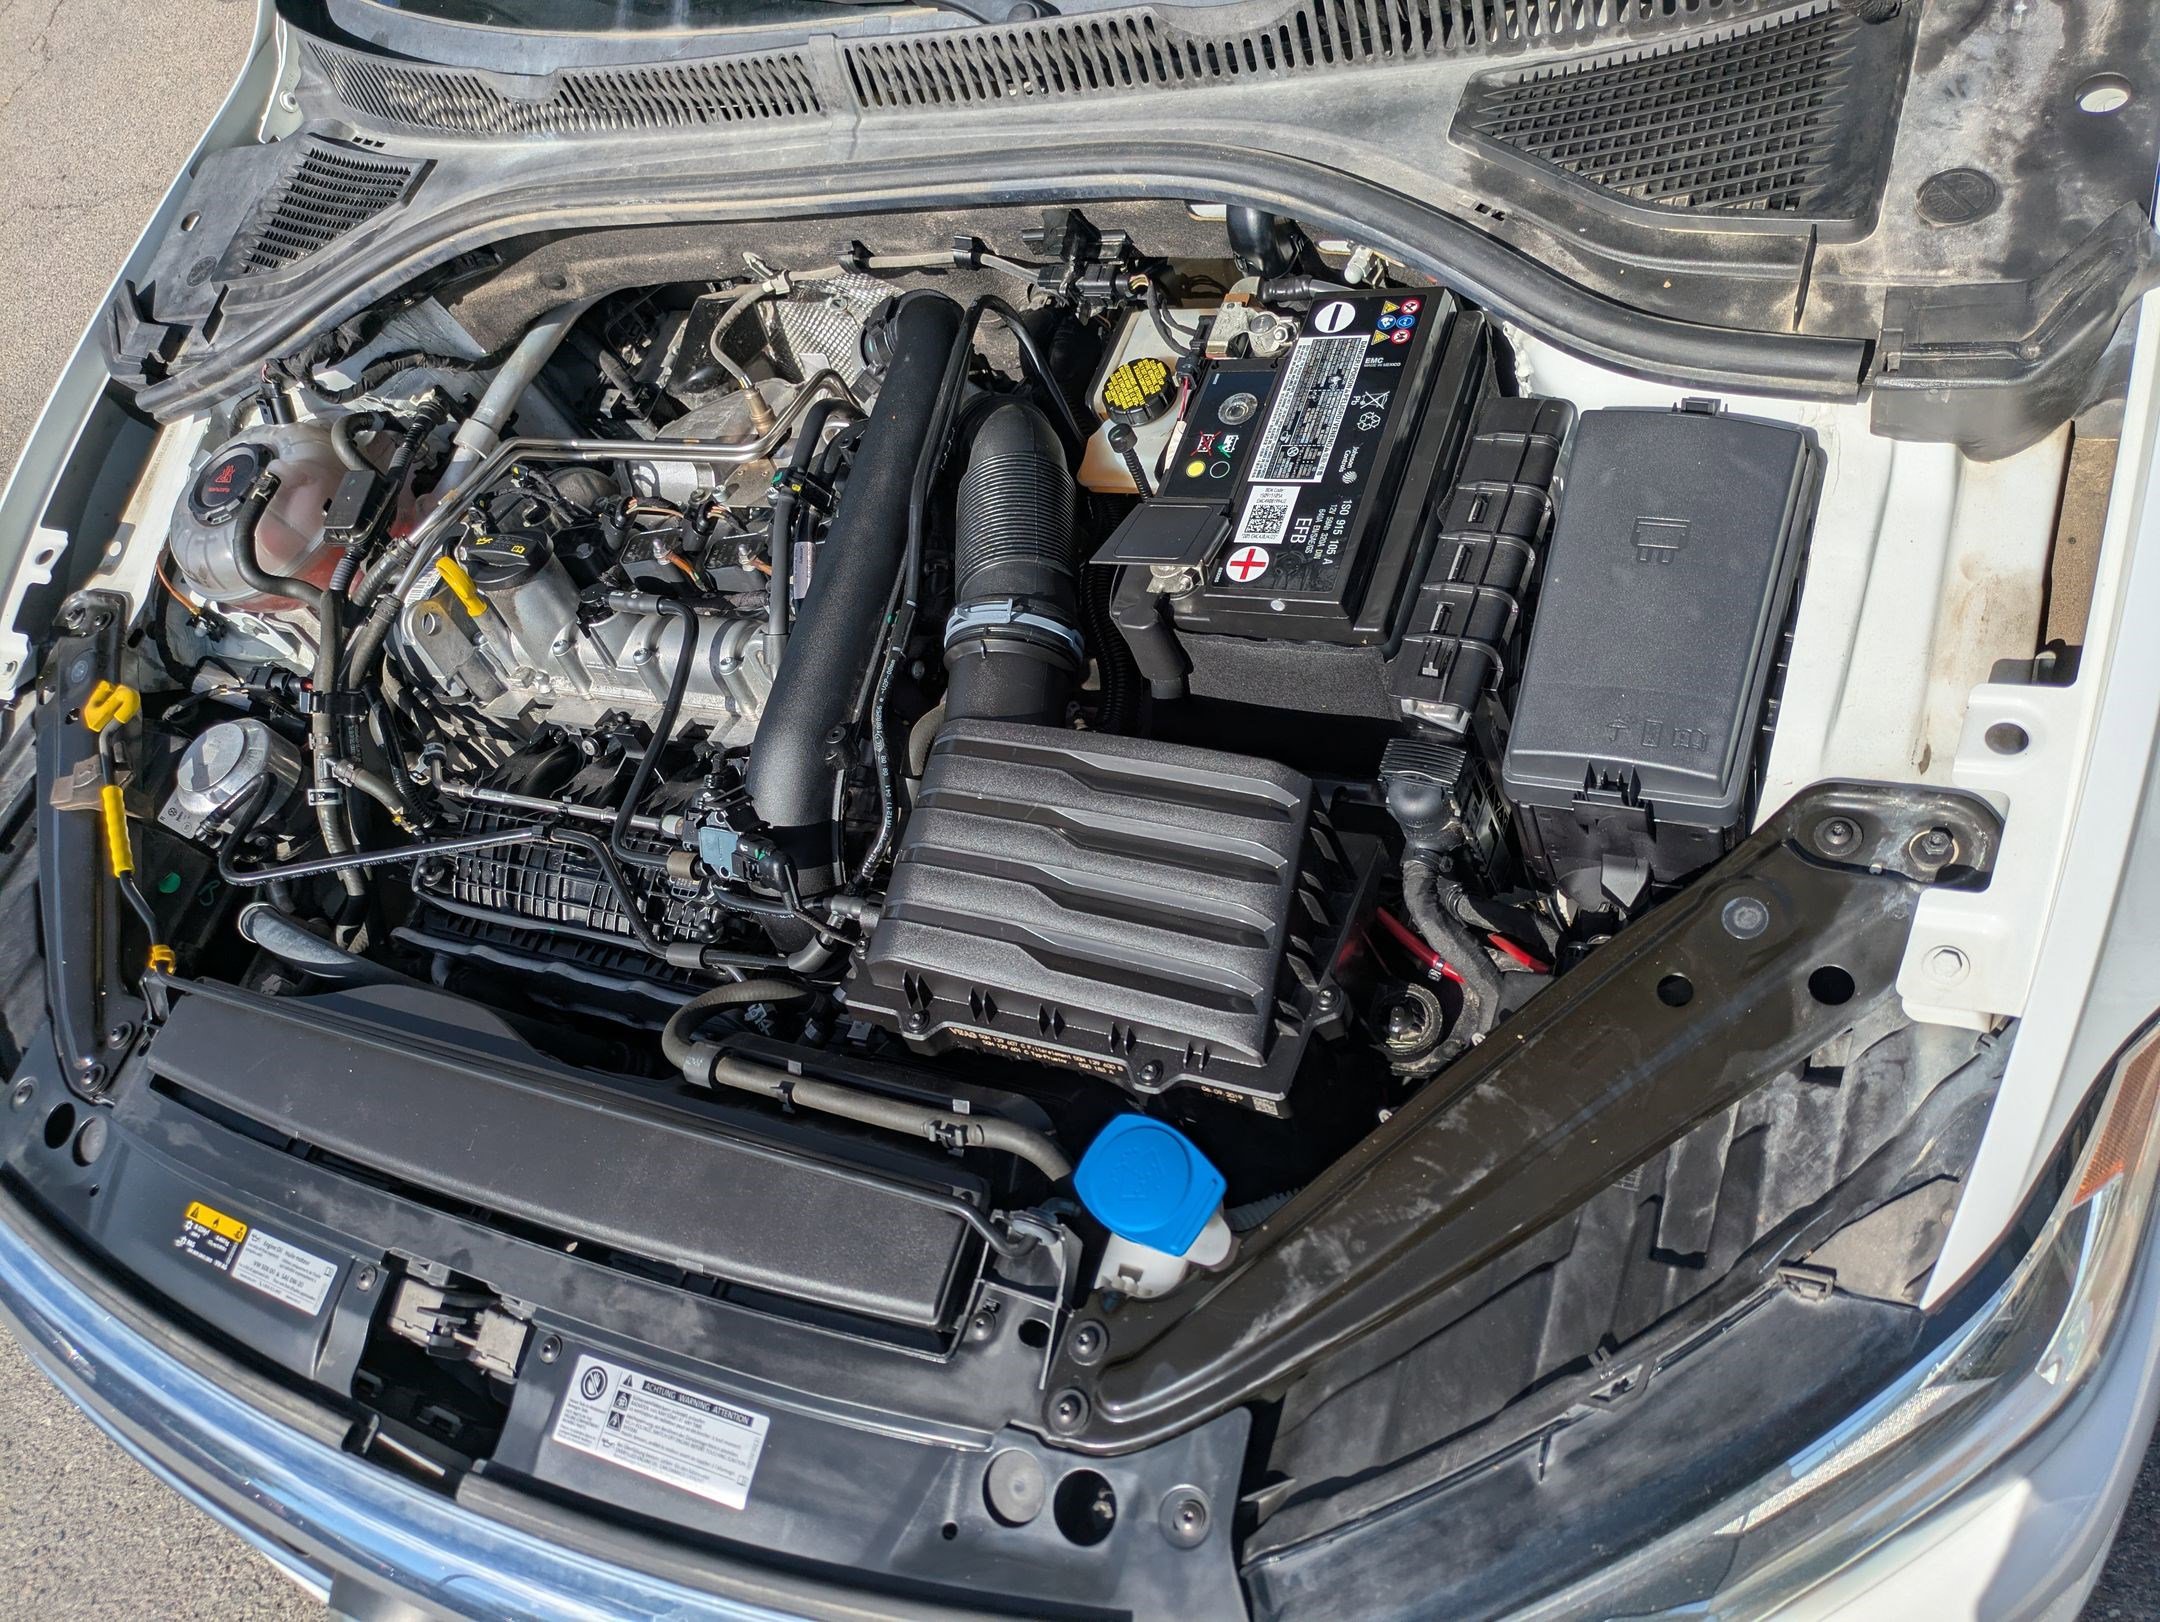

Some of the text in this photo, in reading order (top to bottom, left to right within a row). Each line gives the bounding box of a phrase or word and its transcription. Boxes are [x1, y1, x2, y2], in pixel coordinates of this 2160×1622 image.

[1351, 395, 1360, 406] Pb
[1339, 450, 1351, 472] Controls
[1347, 446, 1360, 469] Johnson
[1315, 508, 1326, 523] 640A
[1328, 504, 1338, 514] 12V
[1290, 518, 1312, 544] EFB
[1332, 520, 1346, 535] 915
[1318, 532, 1328, 547] 320A
[1326, 540, 1339, 554] 105
[1313, 549, 1323, 560] DIN
[645, 1382, 676, 1400] ACHTUNG
[678, 1394, 710, 1412] WARNING
[712, 1406, 750, 1424] ATTENTION
